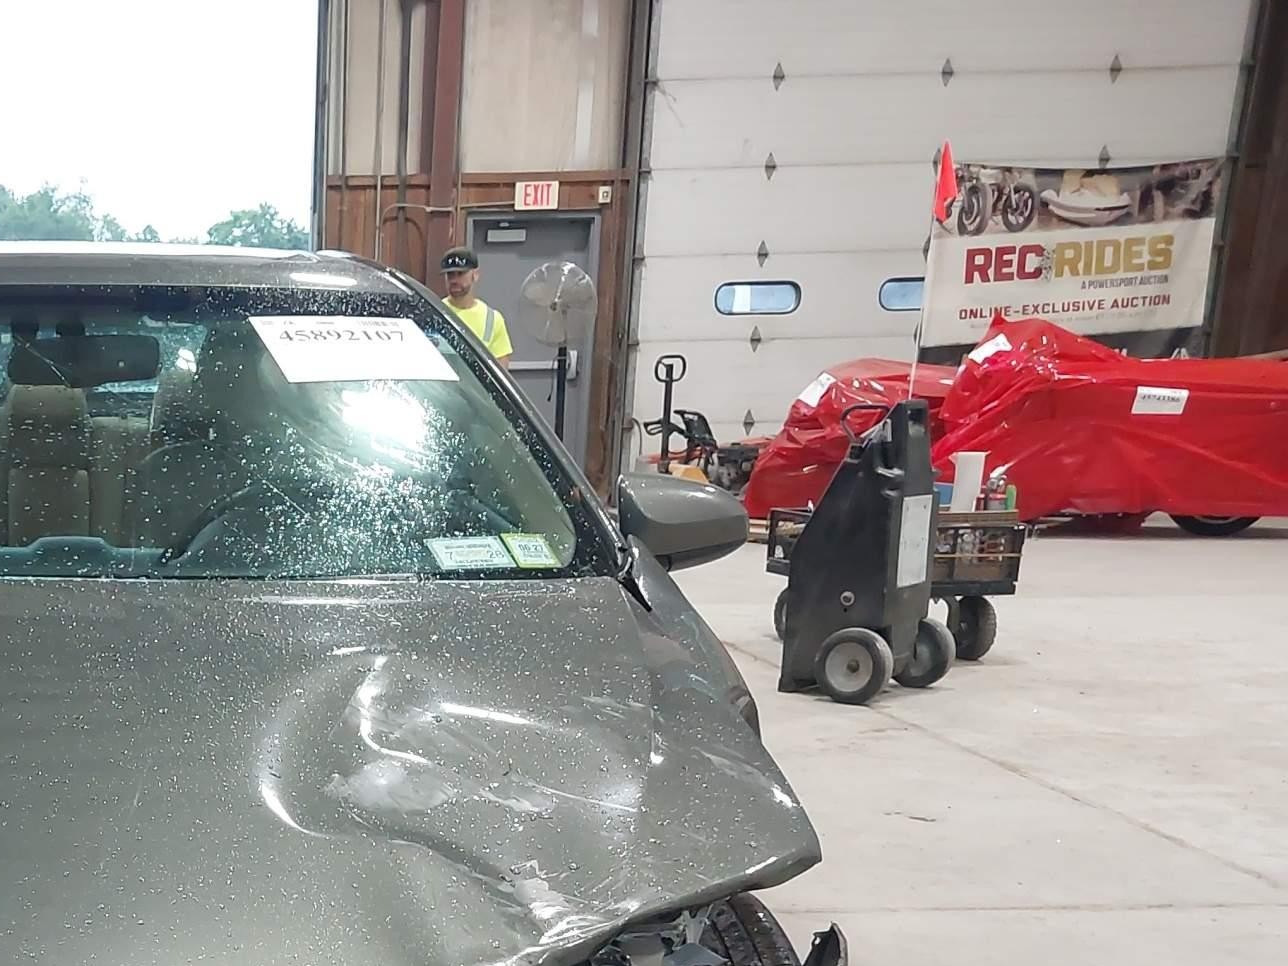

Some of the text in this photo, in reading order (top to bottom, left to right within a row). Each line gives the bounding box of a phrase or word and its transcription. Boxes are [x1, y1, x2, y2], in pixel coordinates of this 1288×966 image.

[523, 183, 552, 206] EXIT
[964, 234, 1175, 284] REC RIDES
[1087, 277, 1138, 289] POWERSPORT
[1139, 274, 1169, 286] AUCTION
[958, 299, 1105, 320] ONLINE-EXCLUSIVE
[1110, 294, 1171, 310] AUCTION
[279, 329, 404, 342] 45892107
